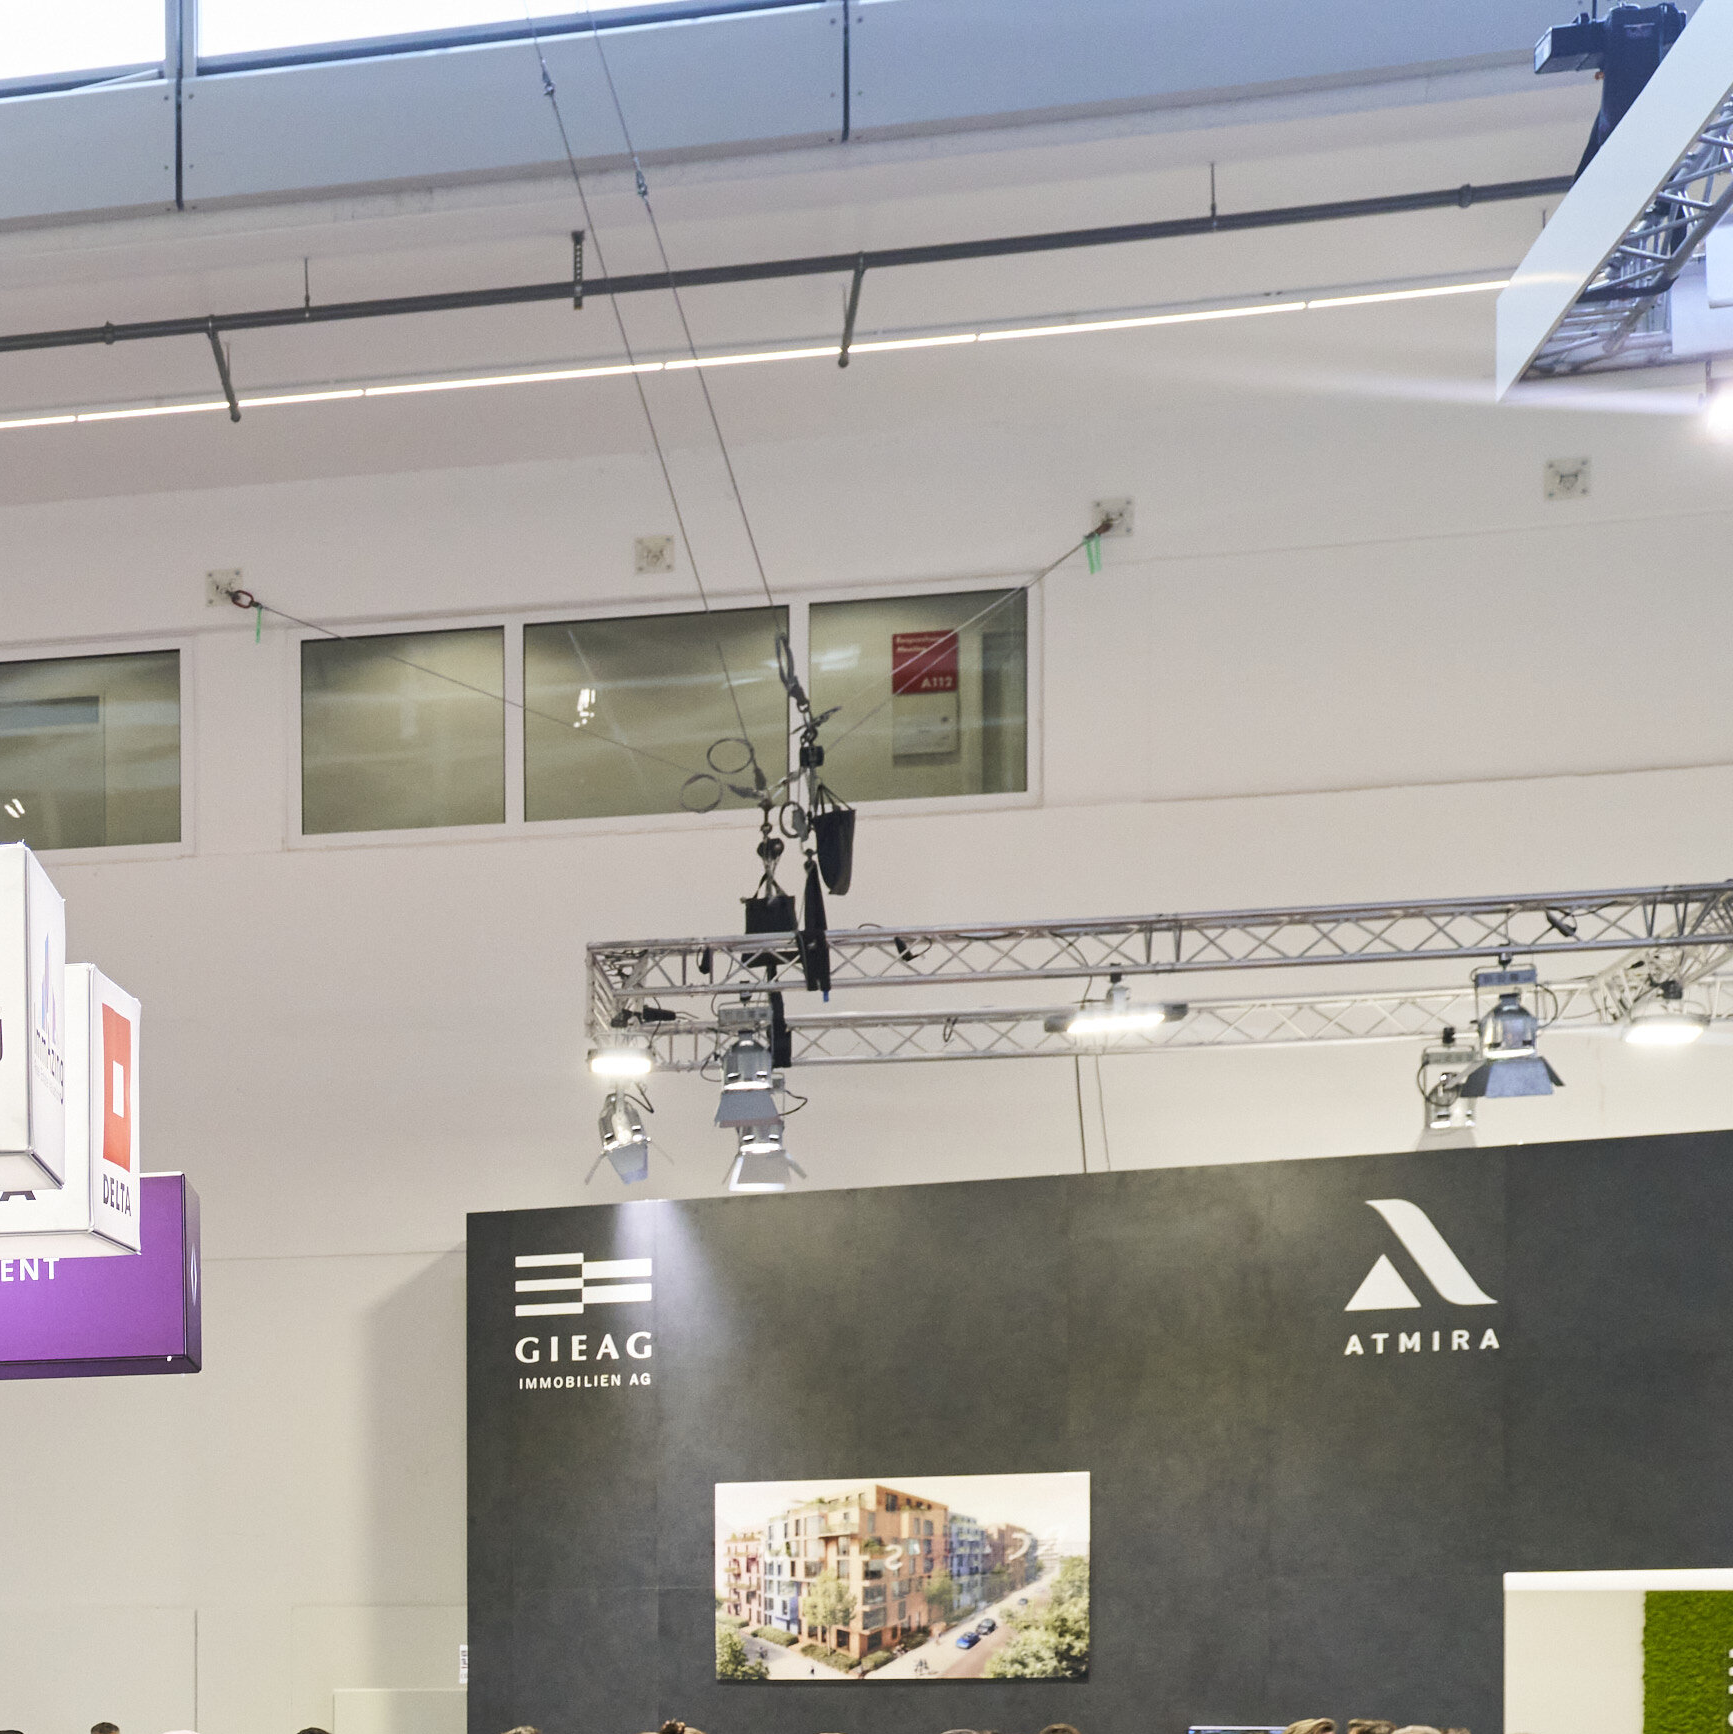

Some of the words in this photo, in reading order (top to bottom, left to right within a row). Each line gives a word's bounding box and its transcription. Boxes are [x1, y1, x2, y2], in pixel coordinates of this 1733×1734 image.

[103, 1174, 132, 1217] DELTA
[515, 1331, 653, 1364] GIEAG
[1344, 1328, 1500, 1356] ATMIRA
[519, 1374, 622, 1390] IMMOBILIEN
[629, 1372, 651, 1386] AG
